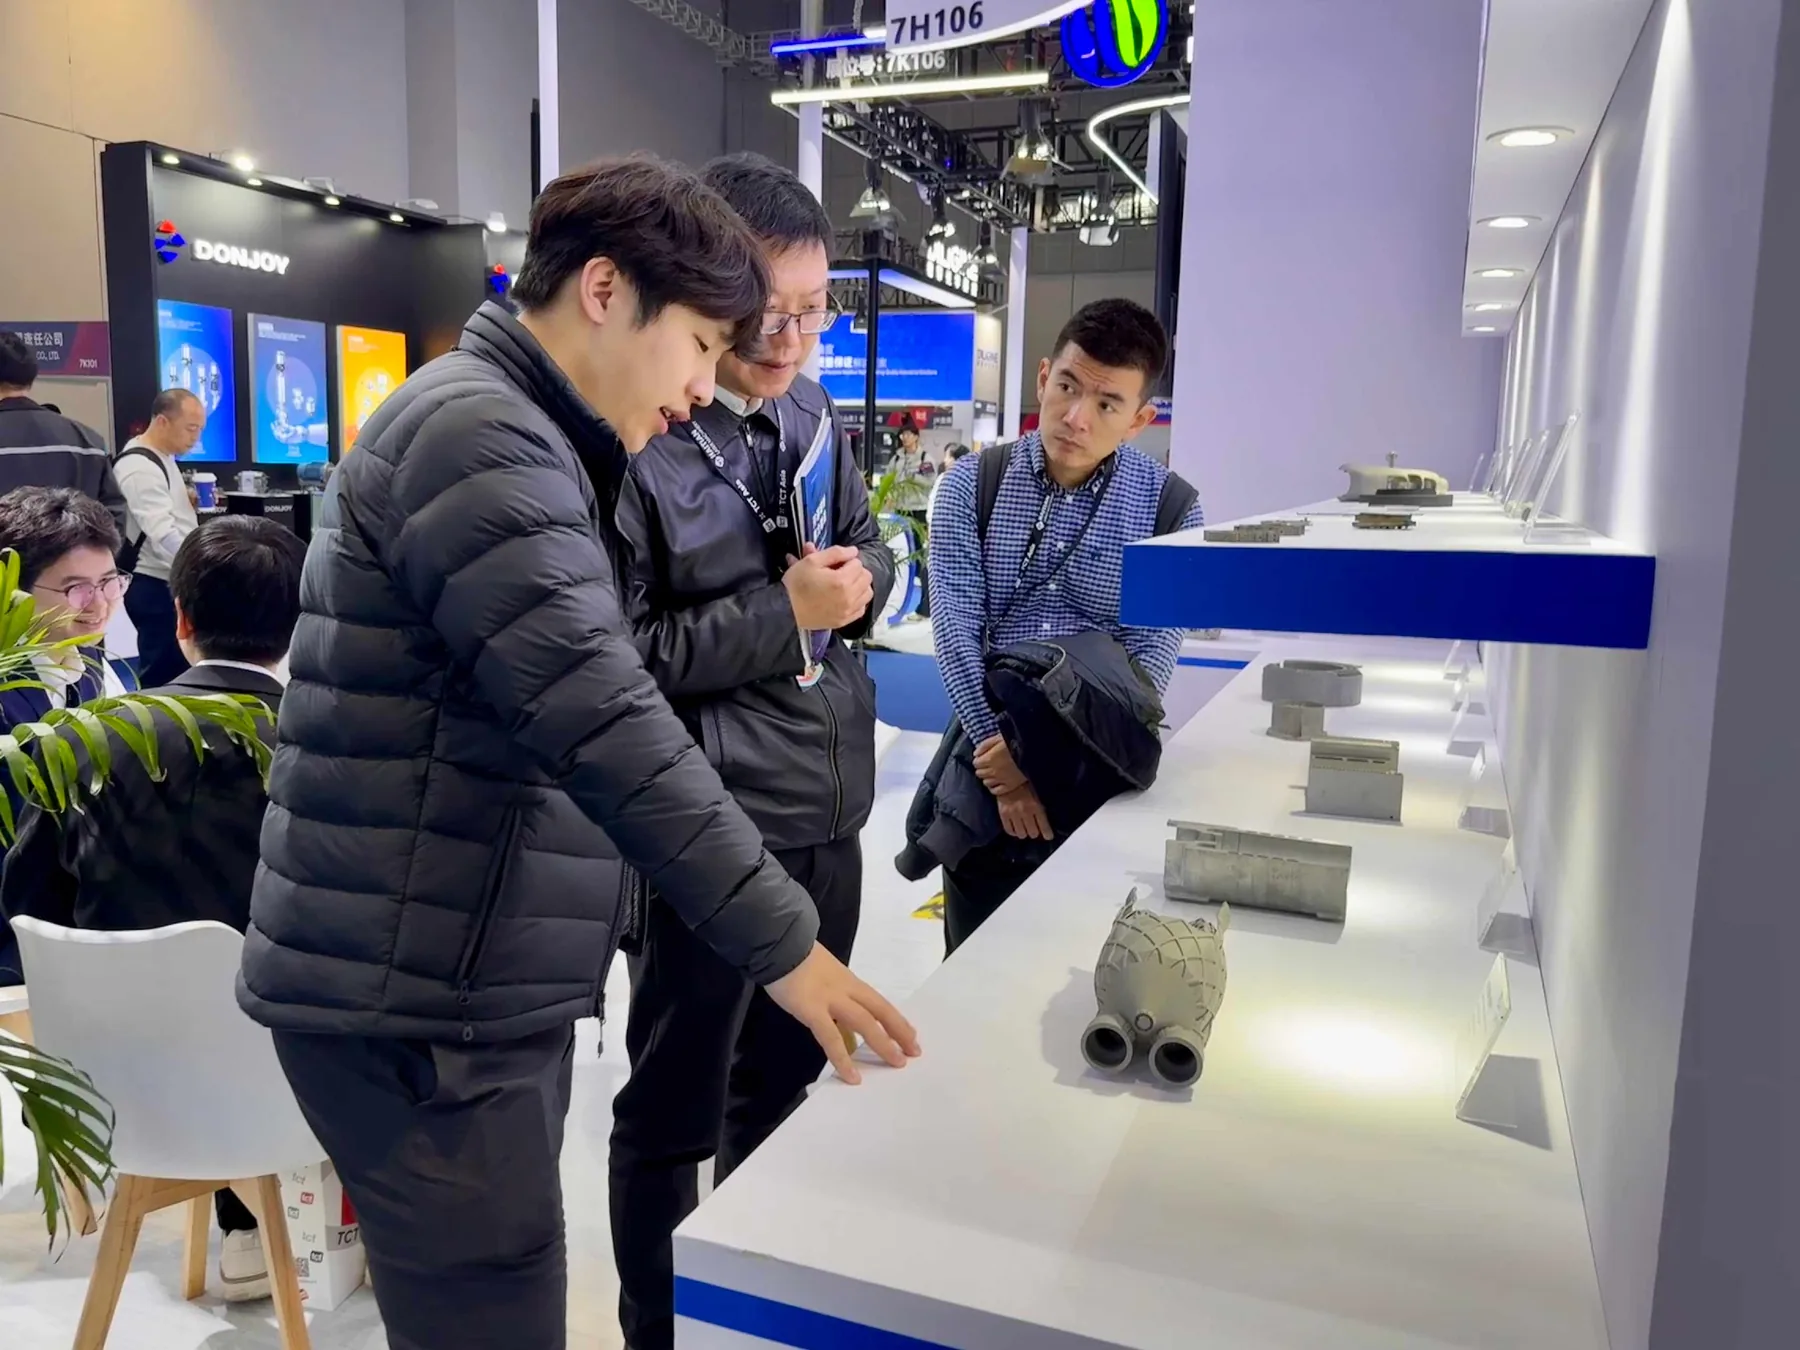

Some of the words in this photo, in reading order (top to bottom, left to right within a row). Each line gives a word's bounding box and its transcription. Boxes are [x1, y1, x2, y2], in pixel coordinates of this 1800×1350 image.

[890, 1, 983, 45] 7H106
[193, 238, 290, 275] DONJOY
[735, 478, 750, 496] Asia
[779, 469, 787, 488] Asia
[747, 496, 761, 513] TCT
[779, 488, 787, 505] TCT
[264, 505, 293, 513] DONJOY
[337, 1227, 359, 1245] TCT
